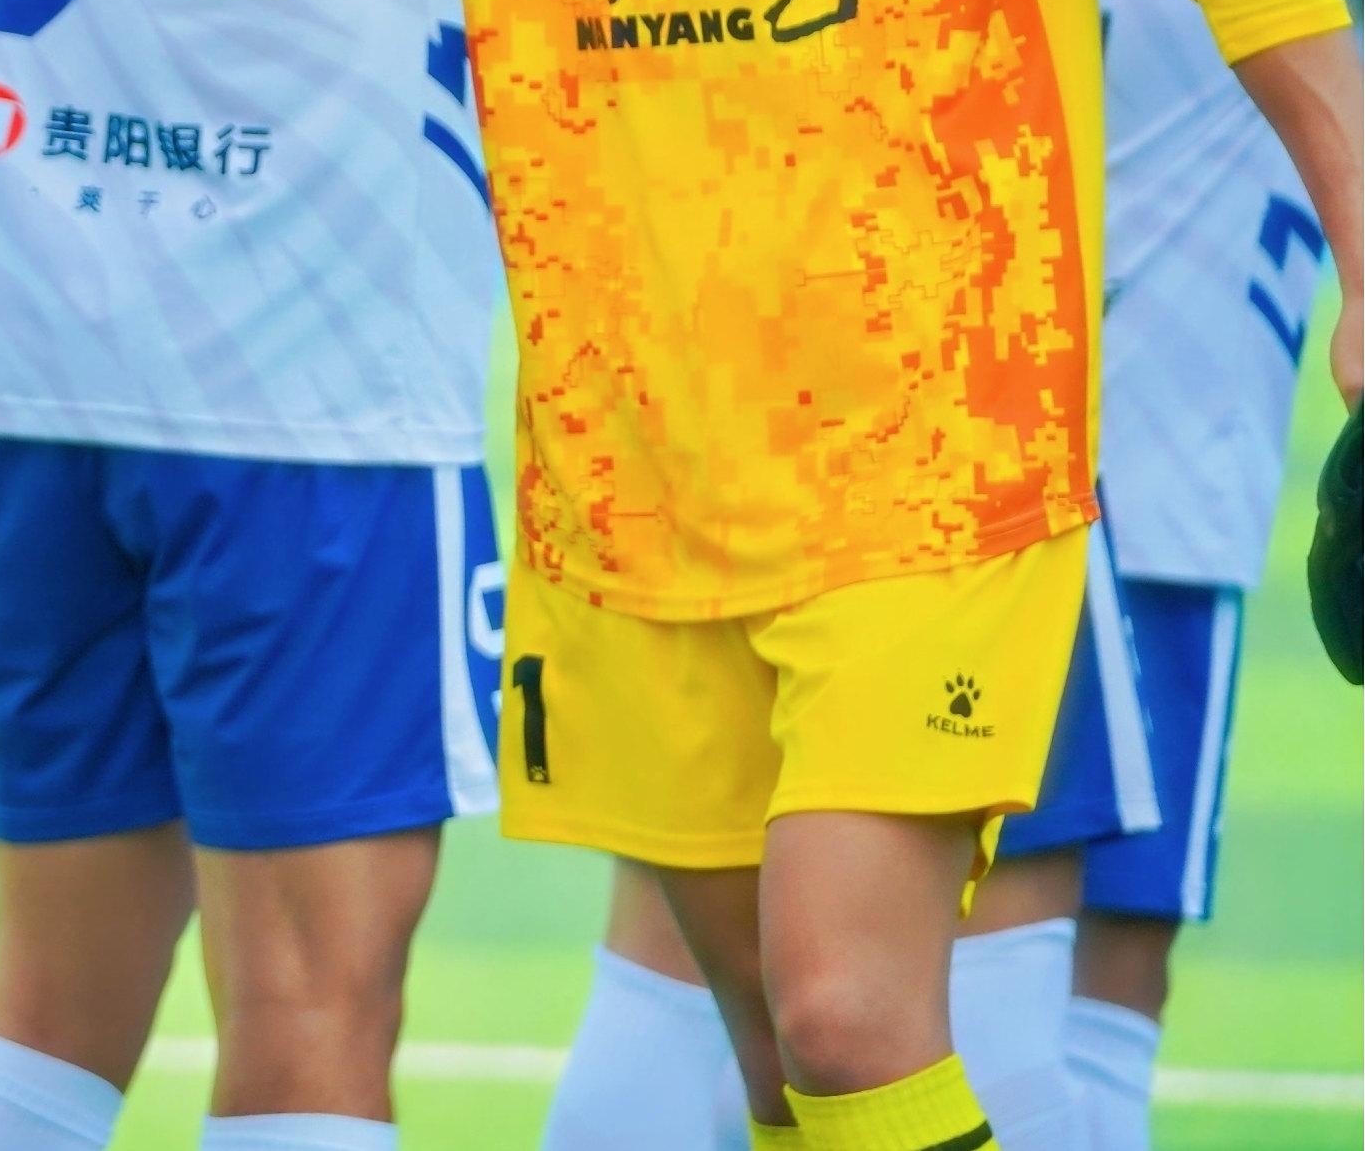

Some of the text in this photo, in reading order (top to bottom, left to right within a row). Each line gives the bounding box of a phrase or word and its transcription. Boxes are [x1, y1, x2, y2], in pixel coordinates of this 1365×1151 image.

[42, 106, 273, 175] 贵阳银行
[512, 653, 550, 784] 1
[925, 713, 997, 738] KELME
